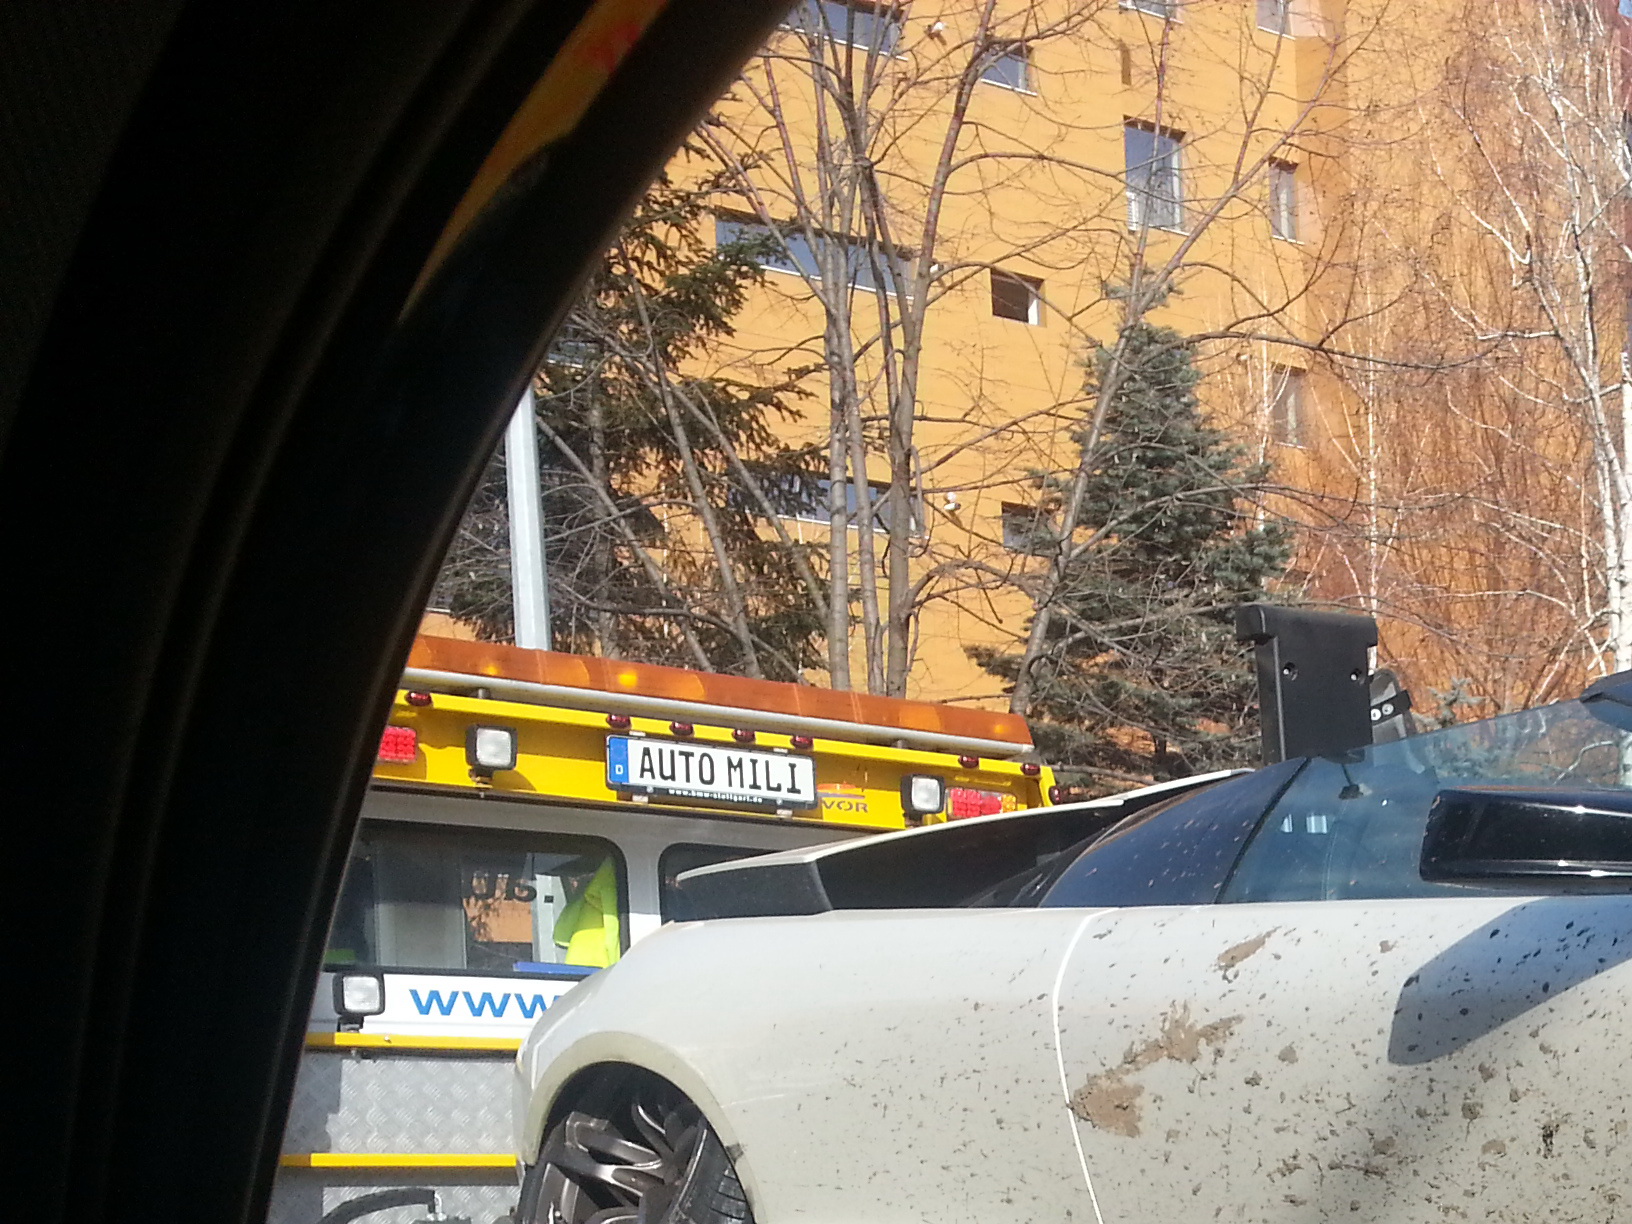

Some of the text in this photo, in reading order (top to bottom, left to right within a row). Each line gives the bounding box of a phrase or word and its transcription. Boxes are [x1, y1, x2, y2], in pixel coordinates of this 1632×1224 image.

[615, 764, 624, 775] D
[638, 746, 802, 794] AUTO MILI
